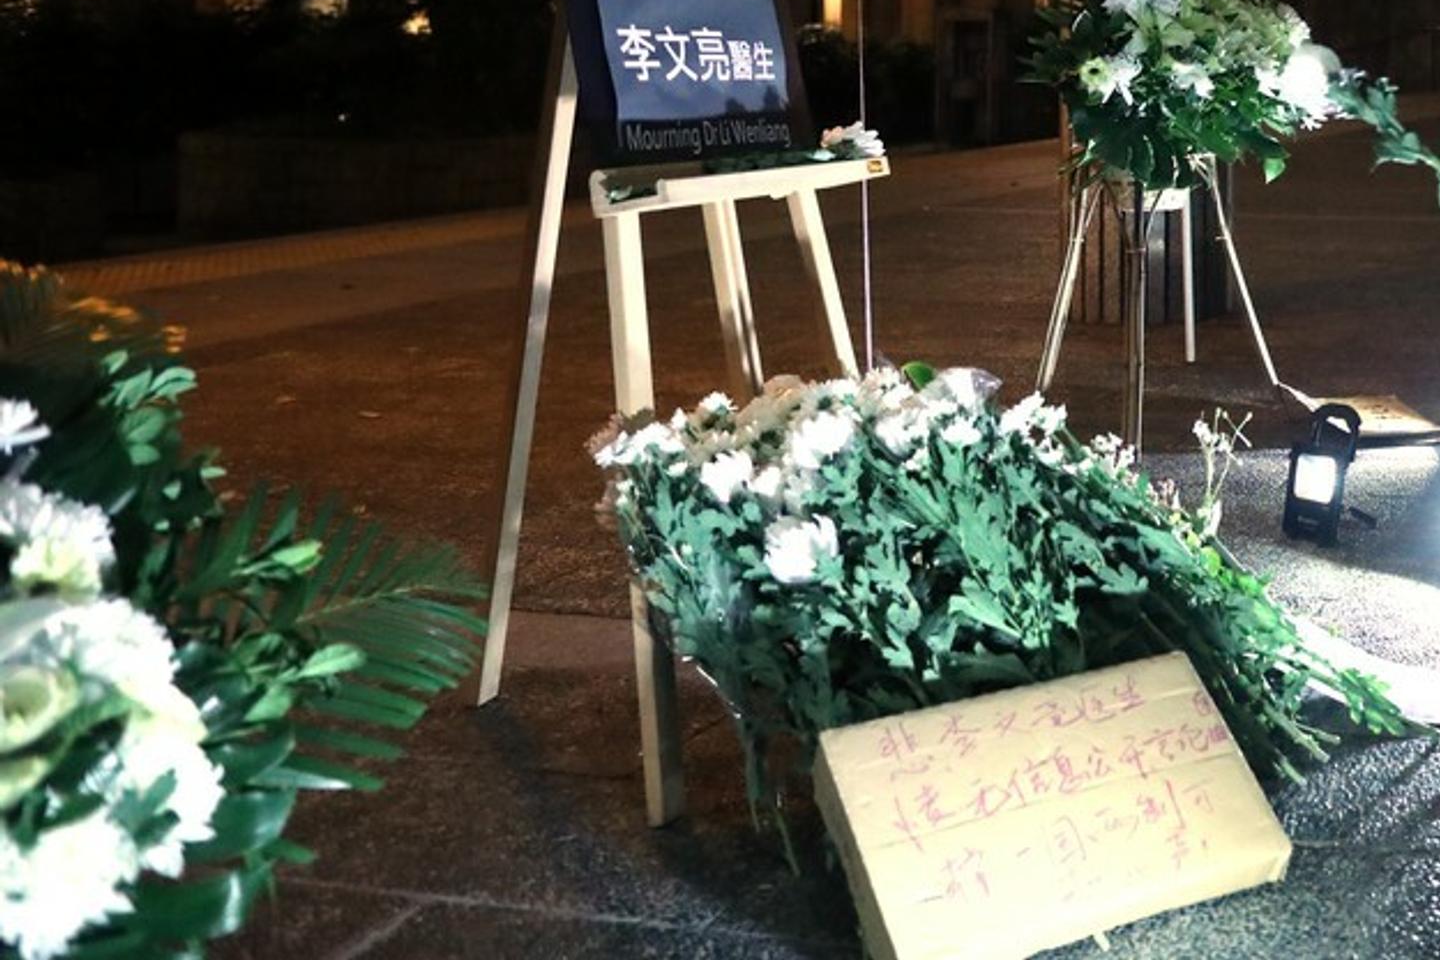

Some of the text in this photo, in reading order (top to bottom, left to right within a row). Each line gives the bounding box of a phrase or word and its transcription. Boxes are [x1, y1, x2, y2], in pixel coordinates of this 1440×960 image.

[616, 24, 776, 82] 李文亮醫生
[626, 119, 703, 155] Mourning
[731, 117, 793, 148] Wenliang
